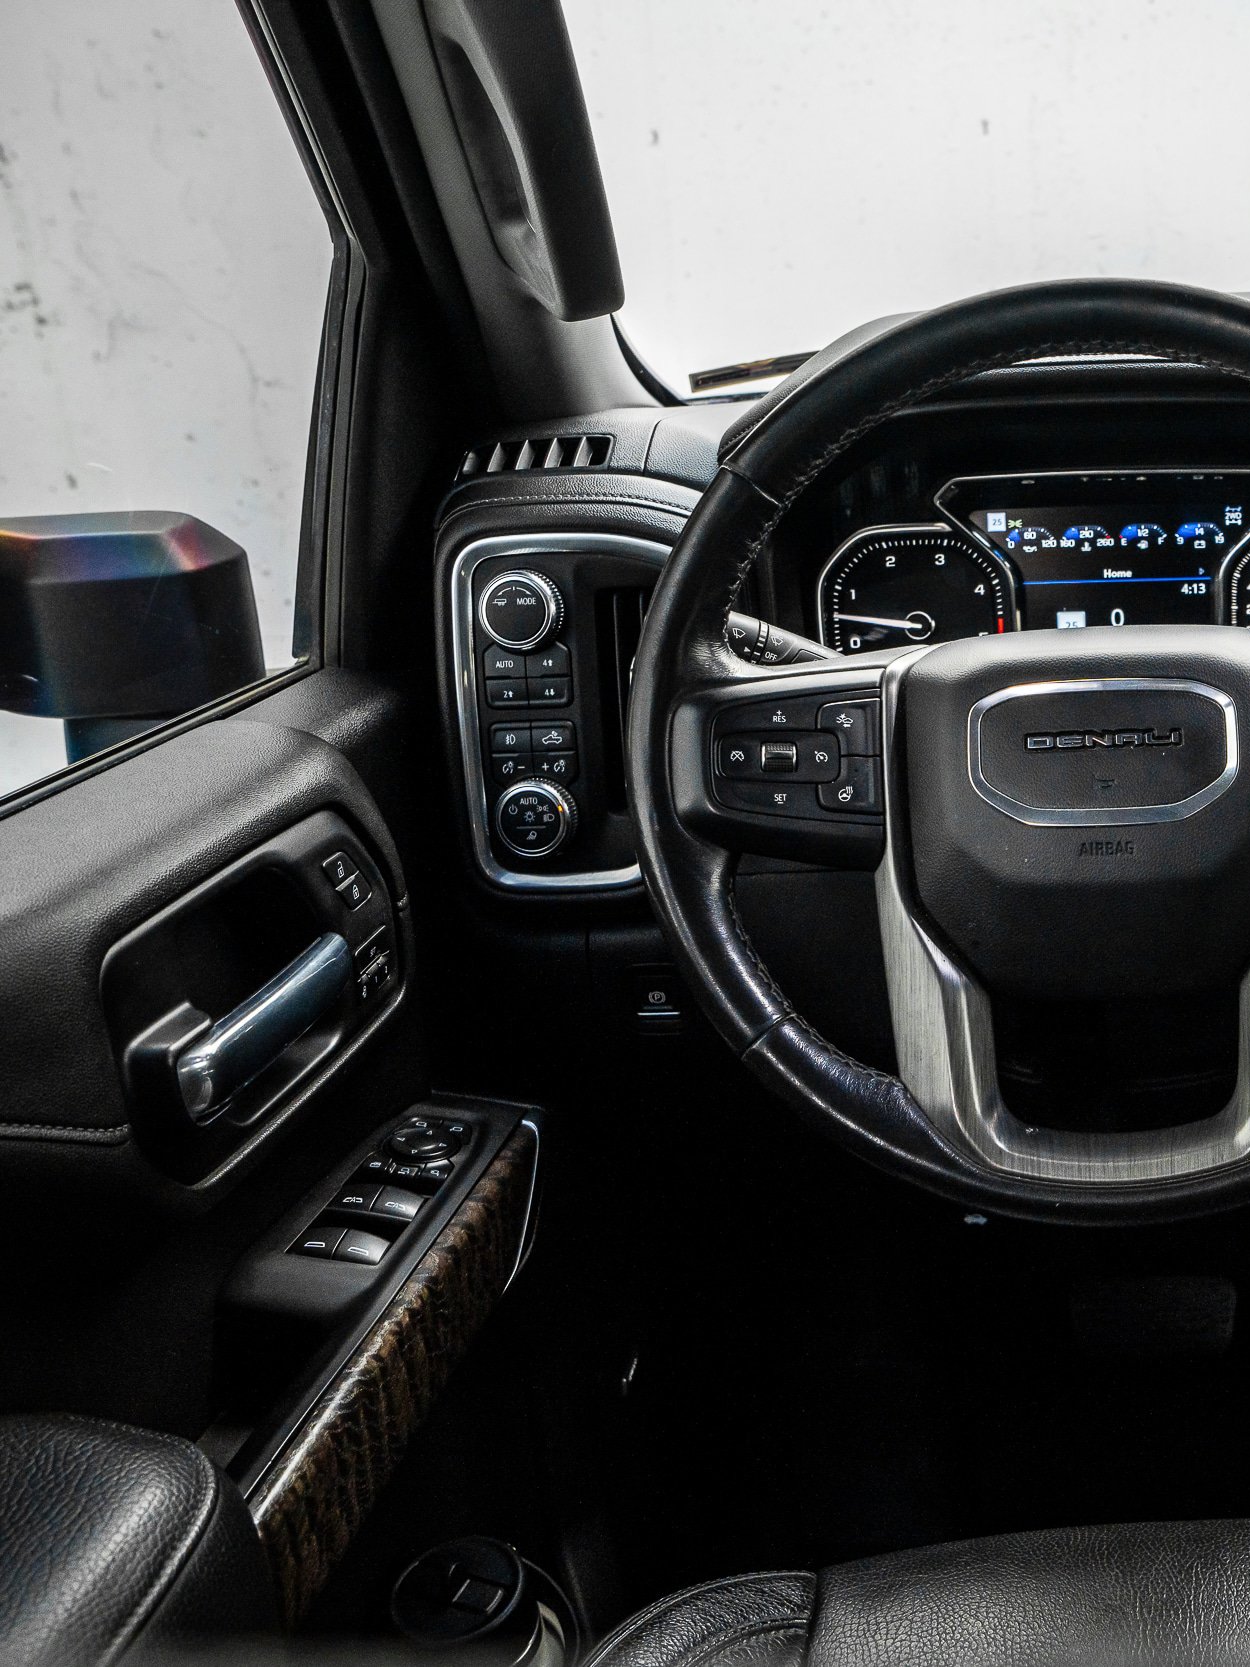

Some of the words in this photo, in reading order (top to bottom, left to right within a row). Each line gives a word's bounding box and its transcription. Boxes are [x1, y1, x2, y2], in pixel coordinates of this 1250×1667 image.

[1225, 512, 1242, 520] 2WD
[1023, 531, 1036, 540] 60
[1079, 530, 1094, 538] 210
[1195, 527, 1205, 536] 14
[1041, 539, 1057, 548] 120
[1060, 539, 1075, 547] 160
[1096, 538, 1114, 547] 260
[1120, 538, 1128, 546] E
[1157, 536, 1164, 545] F
[1176, 536, 1184, 545] 9
[1214, 535, 1225, 544] 19
[1007, 540, 1015, 549] 0
[885, 555, 895, 568] 2
[935, 554, 945, 566] 3
[1103, 568, 1133, 578] Home
[973, 584, 985, 596] 4
[1180, 583, 1207, 595] 4:13
[850, 589, 856, 600] 1
[516, 597, 537, 606] MODE
[1110, 608, 1125, 627] 0
[850, 637, 861, 649] 0
[764, 651, 777, 661] OFF
[495, 660, 514, 668] AUTO
[772, 715, 787, 723] RES
[1025, 729, 1184, 750] DENALI
[519, 797, 538, 805] AUTO
[774, 793, 787, 801] SET
[1079, 840, 1135, 857] AIRBAG
